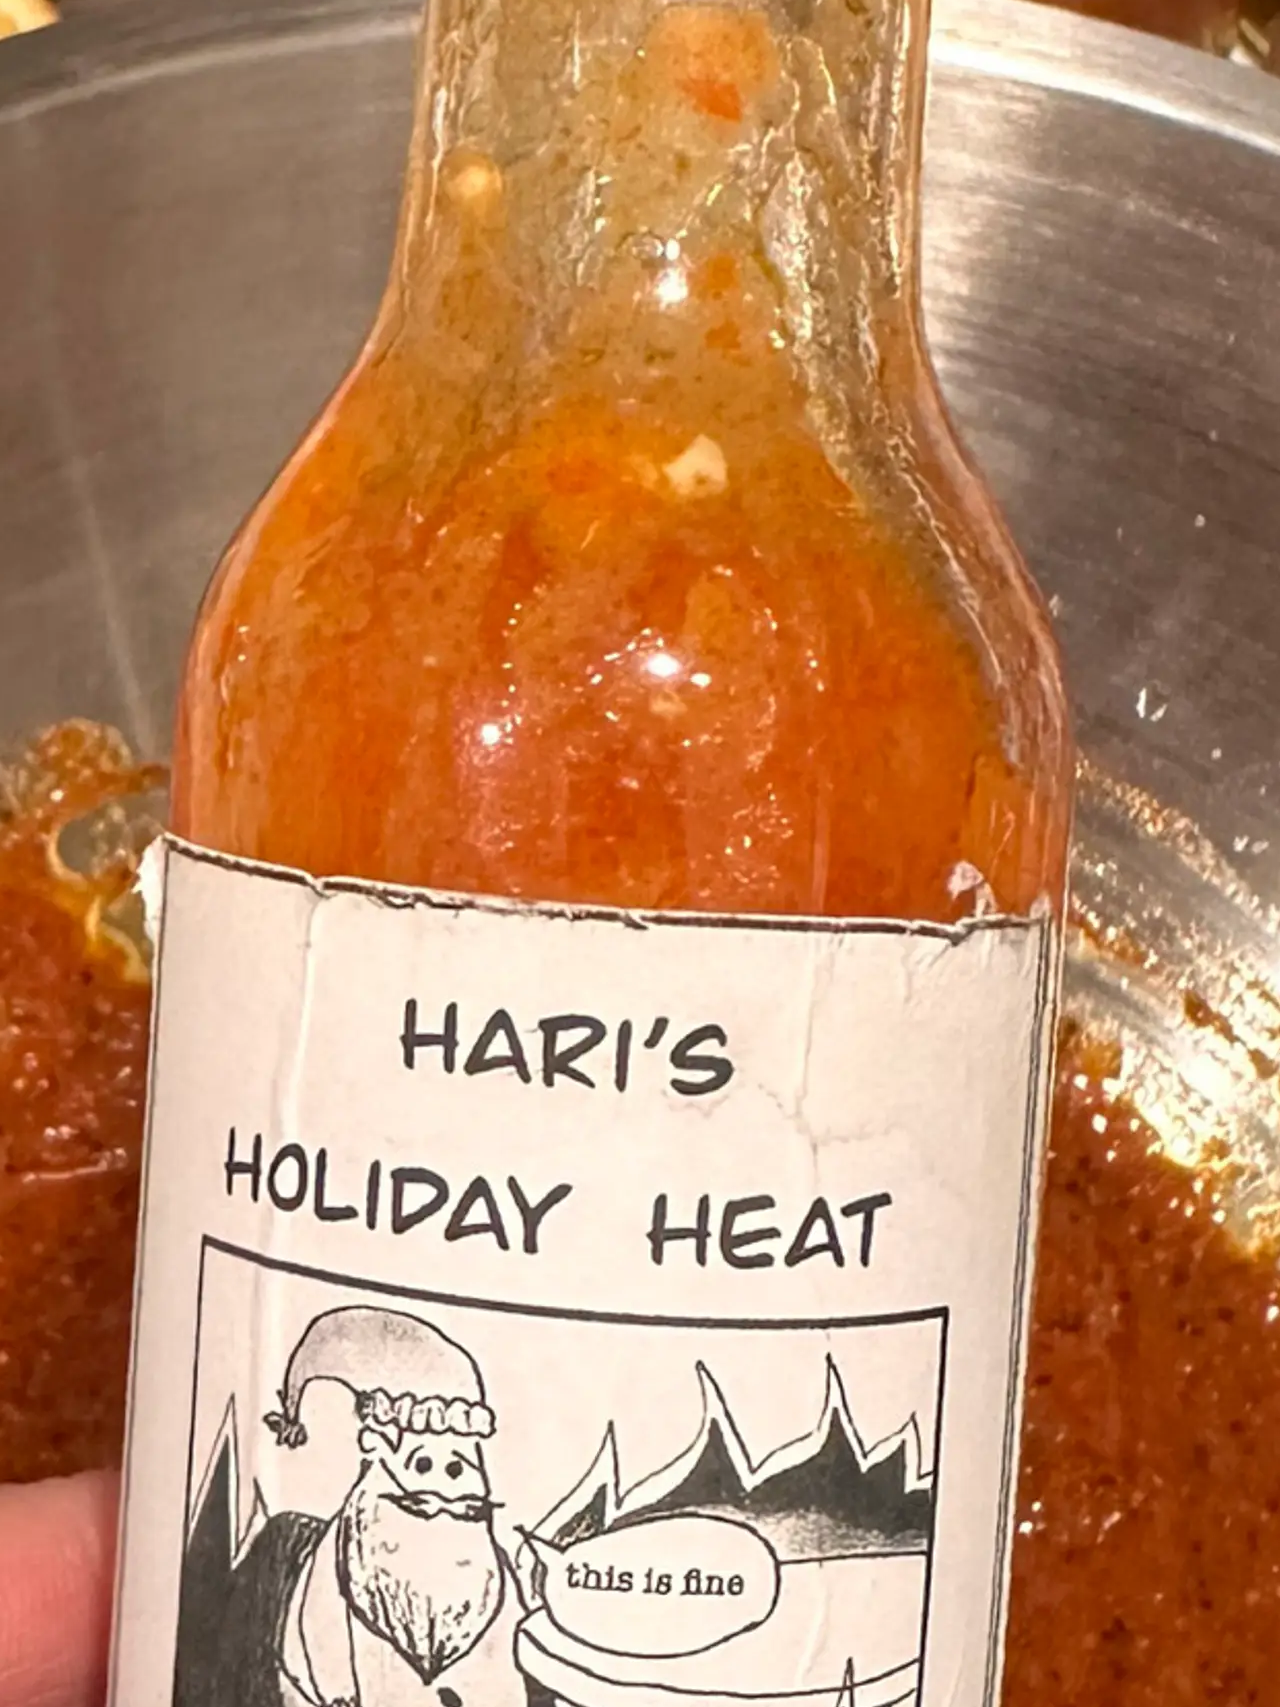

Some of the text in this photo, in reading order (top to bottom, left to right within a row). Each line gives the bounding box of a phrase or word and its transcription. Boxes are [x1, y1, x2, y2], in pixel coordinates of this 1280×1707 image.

[400, 997, 735, 1097] HARI'S
[224, 1126, 893, 1270] HOLIDAY HEAT
[565, 1561, 745, 1596] this is fine
